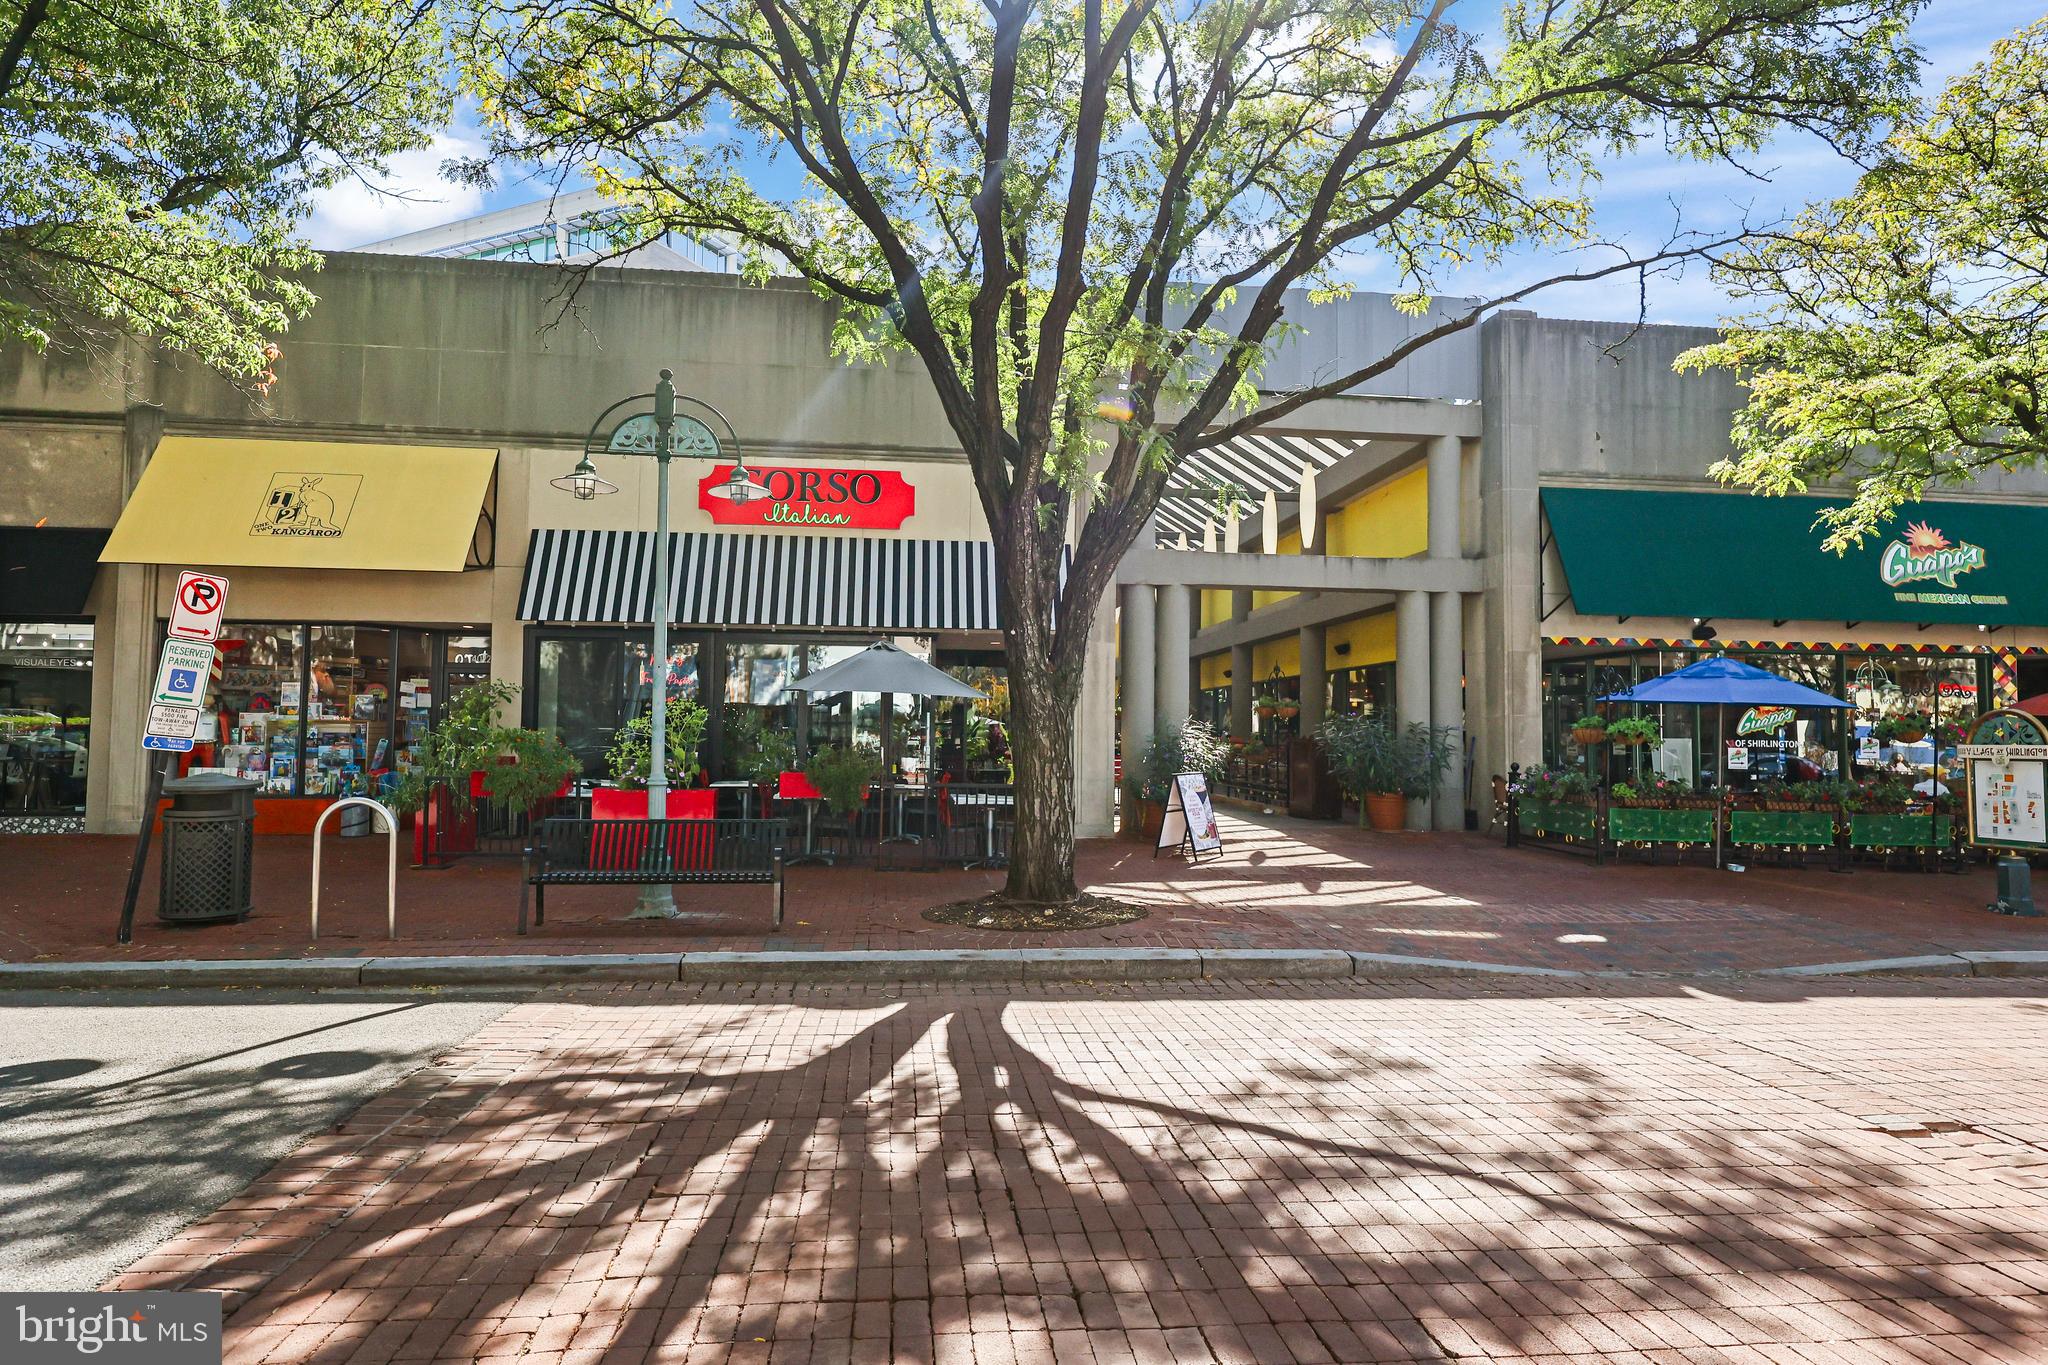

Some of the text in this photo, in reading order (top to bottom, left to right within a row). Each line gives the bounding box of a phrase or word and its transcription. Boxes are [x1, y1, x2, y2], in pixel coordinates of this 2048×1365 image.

[748, 469, 882, 504] ORSO
[764, 502, 851, 525] Italian
[253, 521, 270, 529] ONE
[256, 525, 273, 533] TWO
[1882, 543, 1979, 584] Guapo's
[1917, 593, 1971, 605] MEXICAN
[168, 645, 211, 659] RESERVED
[14, 658, 77, 667] VISUALEYES
[167, 656, 206, 669] PARKING
[151, 716, 180, 724] TOW-AWAY
[1740, 708, 1794, 734] Guapo's
[1735, 740, 1746, 748] OF
[2005, 746, 2048, 757] SHIRLINGTON
